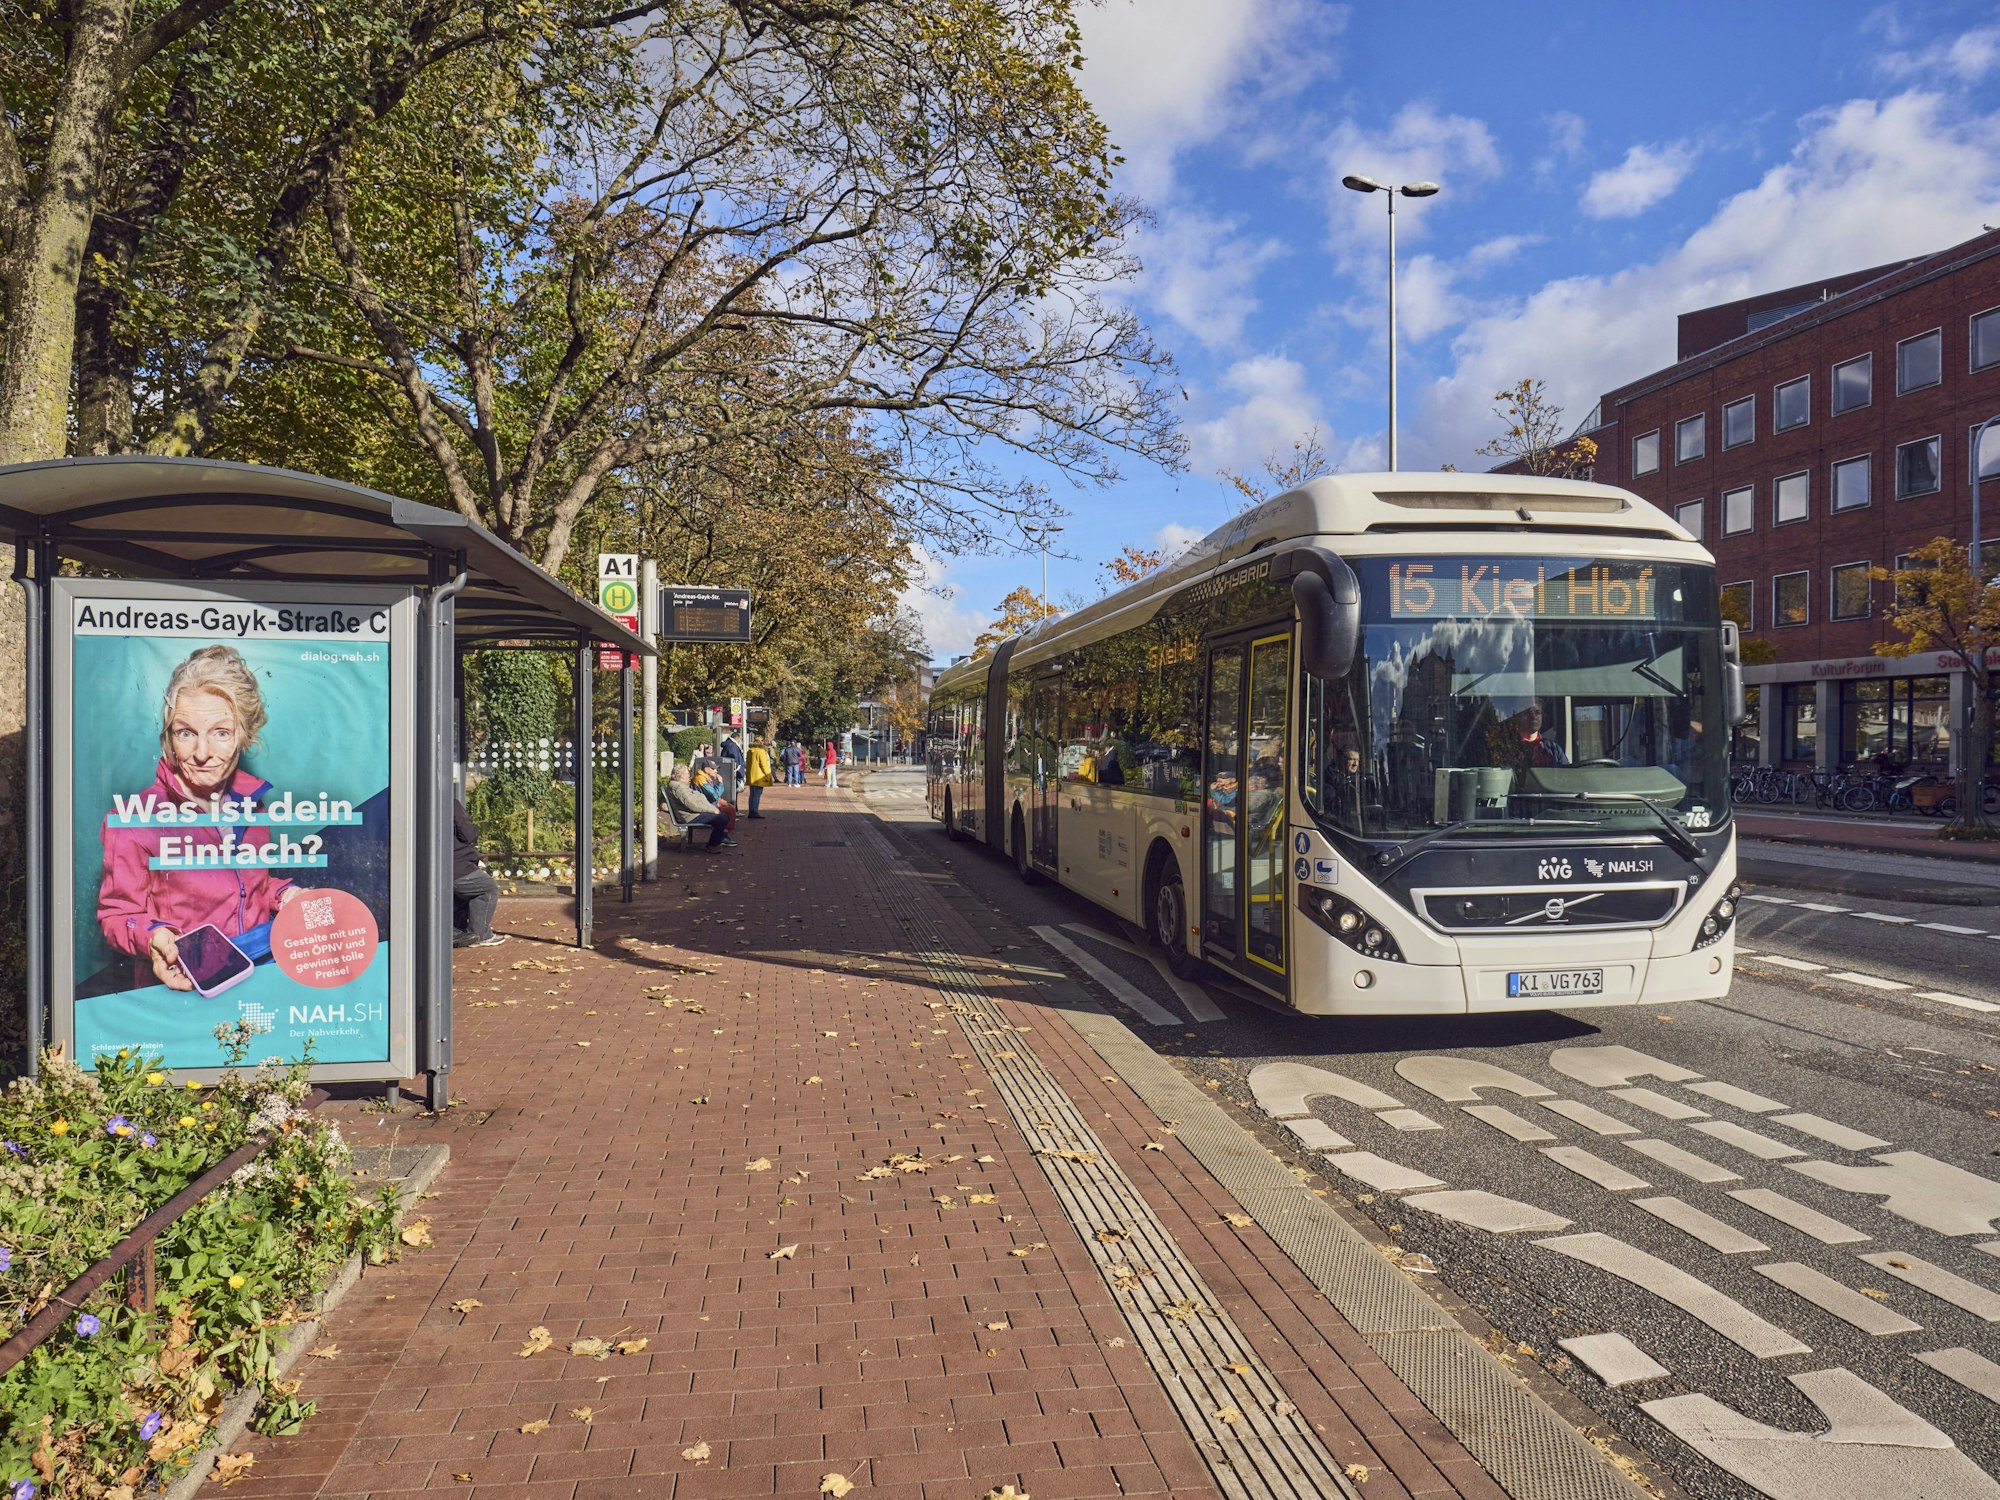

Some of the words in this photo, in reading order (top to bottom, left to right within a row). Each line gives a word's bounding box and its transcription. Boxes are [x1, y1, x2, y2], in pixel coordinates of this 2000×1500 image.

[604, 558, 632, 575] A1
[1223, 561, 1269, 590] HYBRID
[1389, 564, 1435, 613] 15
[1461, 565, 1545, 614] Kiel
[1568, 566, 1653, 615] Hbf
[77, 604, 360, 636] Andreas-Gayk-Straße
[369, 611, 387, 634] C
[300, 650, 380, 664] dialog.nah.sh
[1811, 662, 1885, 677] KulturForum
[113, 794, 198, 823] Was
[210, 791, 257, 823] ist
[268, 791, 353, 822] dein
[1686, 812, 1710, 828] 763
[159, 834, 324, 866] Einfach?
[1538, 864, 1573, 880] KVG
[1608, 860, 1653, 873] NAH.SH
[283, 934, 328, 948] Gestalte
[330, 930, 346, 940] mit
[347, 927, 366, 936] uns
[289, 949, 310, 960] den
[311, 942, 343, 956] ÖPNV
[345, 938, 365, 949] und
[295, 957, 340, 974] gewinne
[341, 952, 364, 964] tolle
[315, 966, 350, 980] Preise!
[1519, 975, 1538, 991] KI
[289, 1002, 382, 1024] NAH.SH
[289, 1029, 306, 1038] Der
[91, 1041, 164, 1052] Schleswig-Holstein
